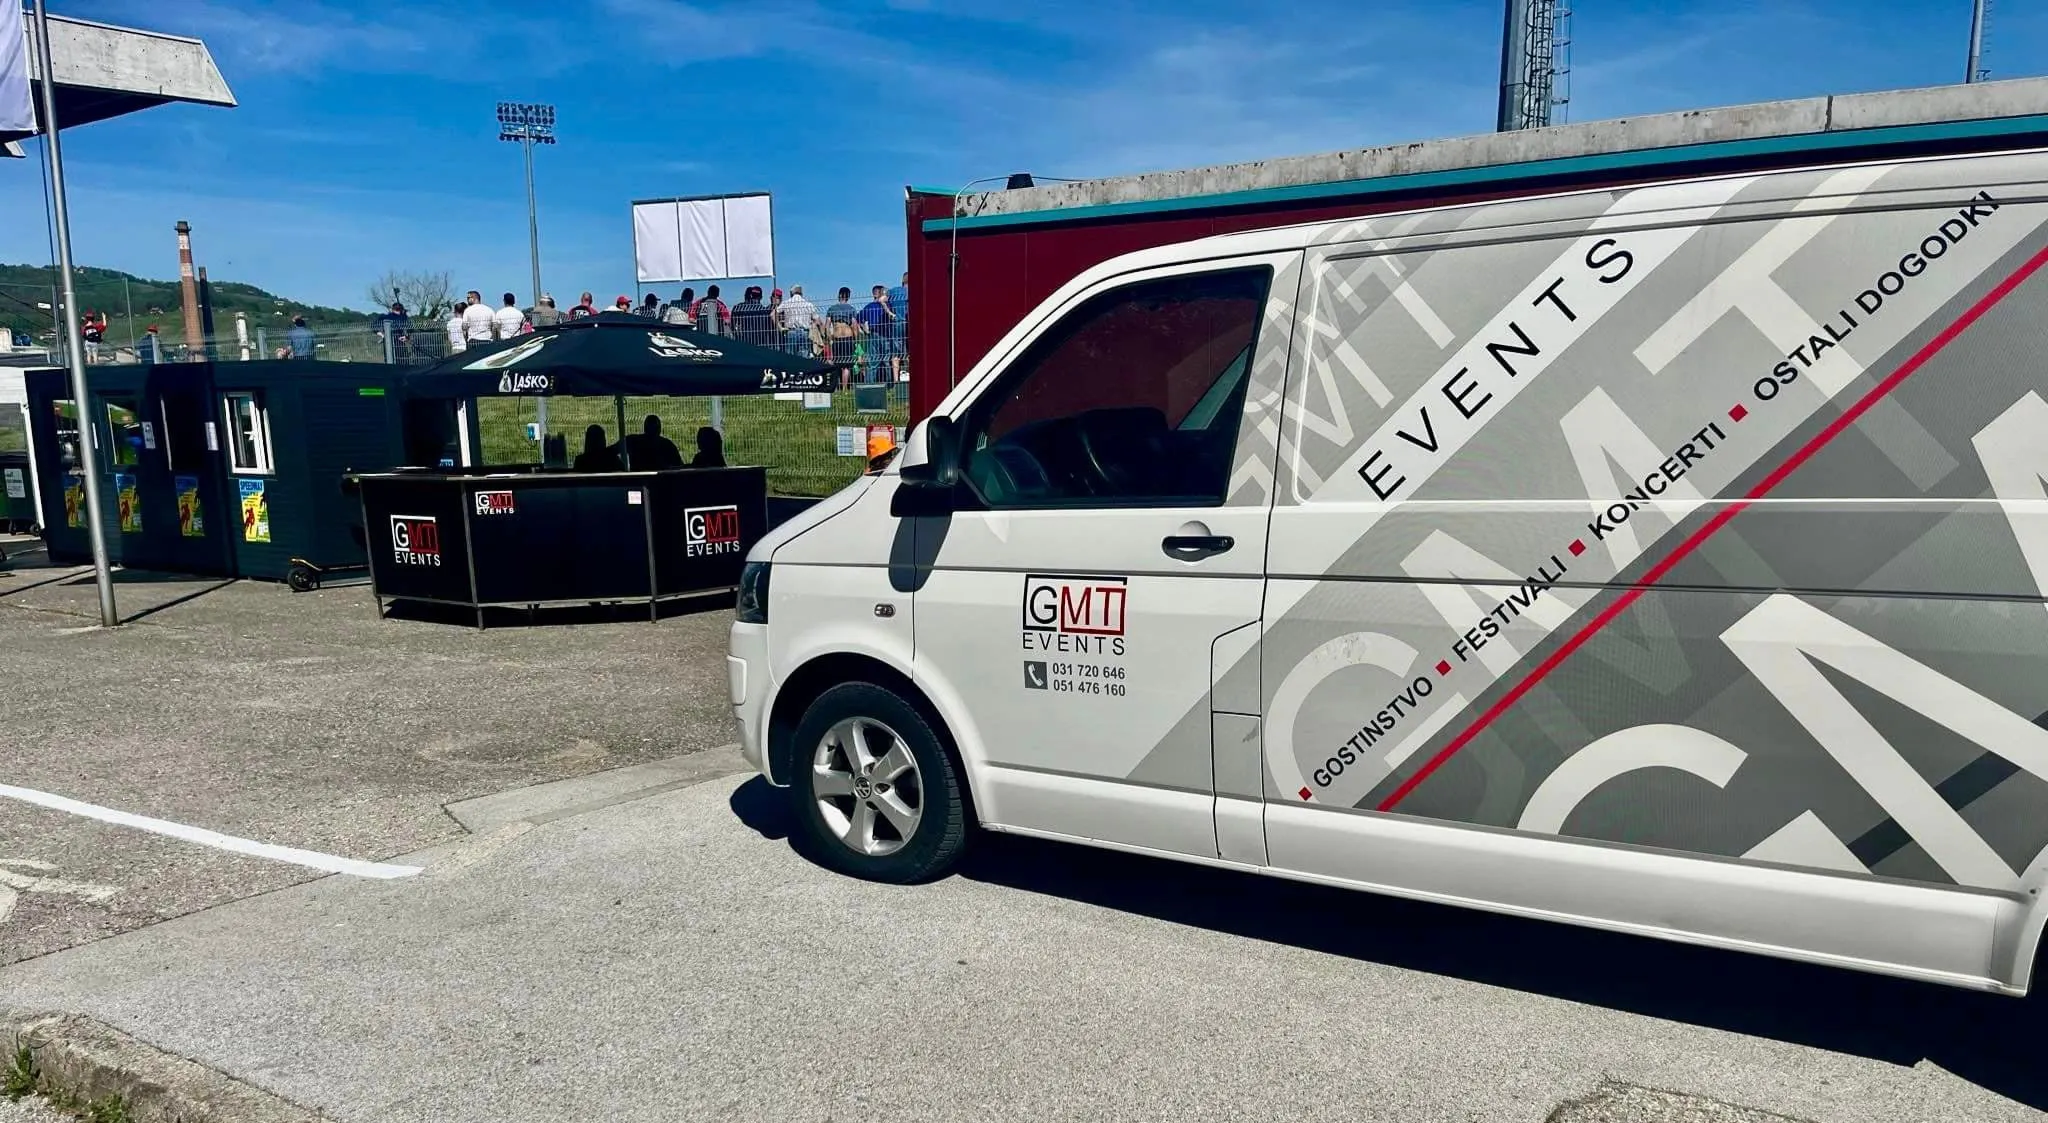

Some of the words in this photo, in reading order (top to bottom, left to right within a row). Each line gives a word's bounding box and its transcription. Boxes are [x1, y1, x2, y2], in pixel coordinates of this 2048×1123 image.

[1357, 238, 1634, 502] EVENTS
[512, 372, 548, 392] LAŠKO
[1313, 676, 1433, 788] GOSTINSTVO
[1451, 555, 1568, 662] FESTIVALI
[1587, 422, 1726, 541] KONCERTI
[1753, 309, 1859, 401] OSTALI
[1854, 190, 2001, 316] DOGODKI
[477, 493, 514, 508] GMT
[476, 507, 515, 515] EVENTS
[394, 519, 439, 551] GMT
[688, 510, 739, 541] GMT
[686, 540, 741, 557] EVENTS
[395, 551, 441, 567] EVENTS
[1028, 584, 1126, 629] GMT
[1022, 632, 1125, 656] EVENTS
[1052, 662, 1073, 676] 031
[1077, 664, 1099, 678] 720
[1103, 666, 1126, 680] 646
[1053, 679, 1074, 693] 051
[1078, 681, 1100, 695] 476
[1104, 683, 1126, 697] 160
